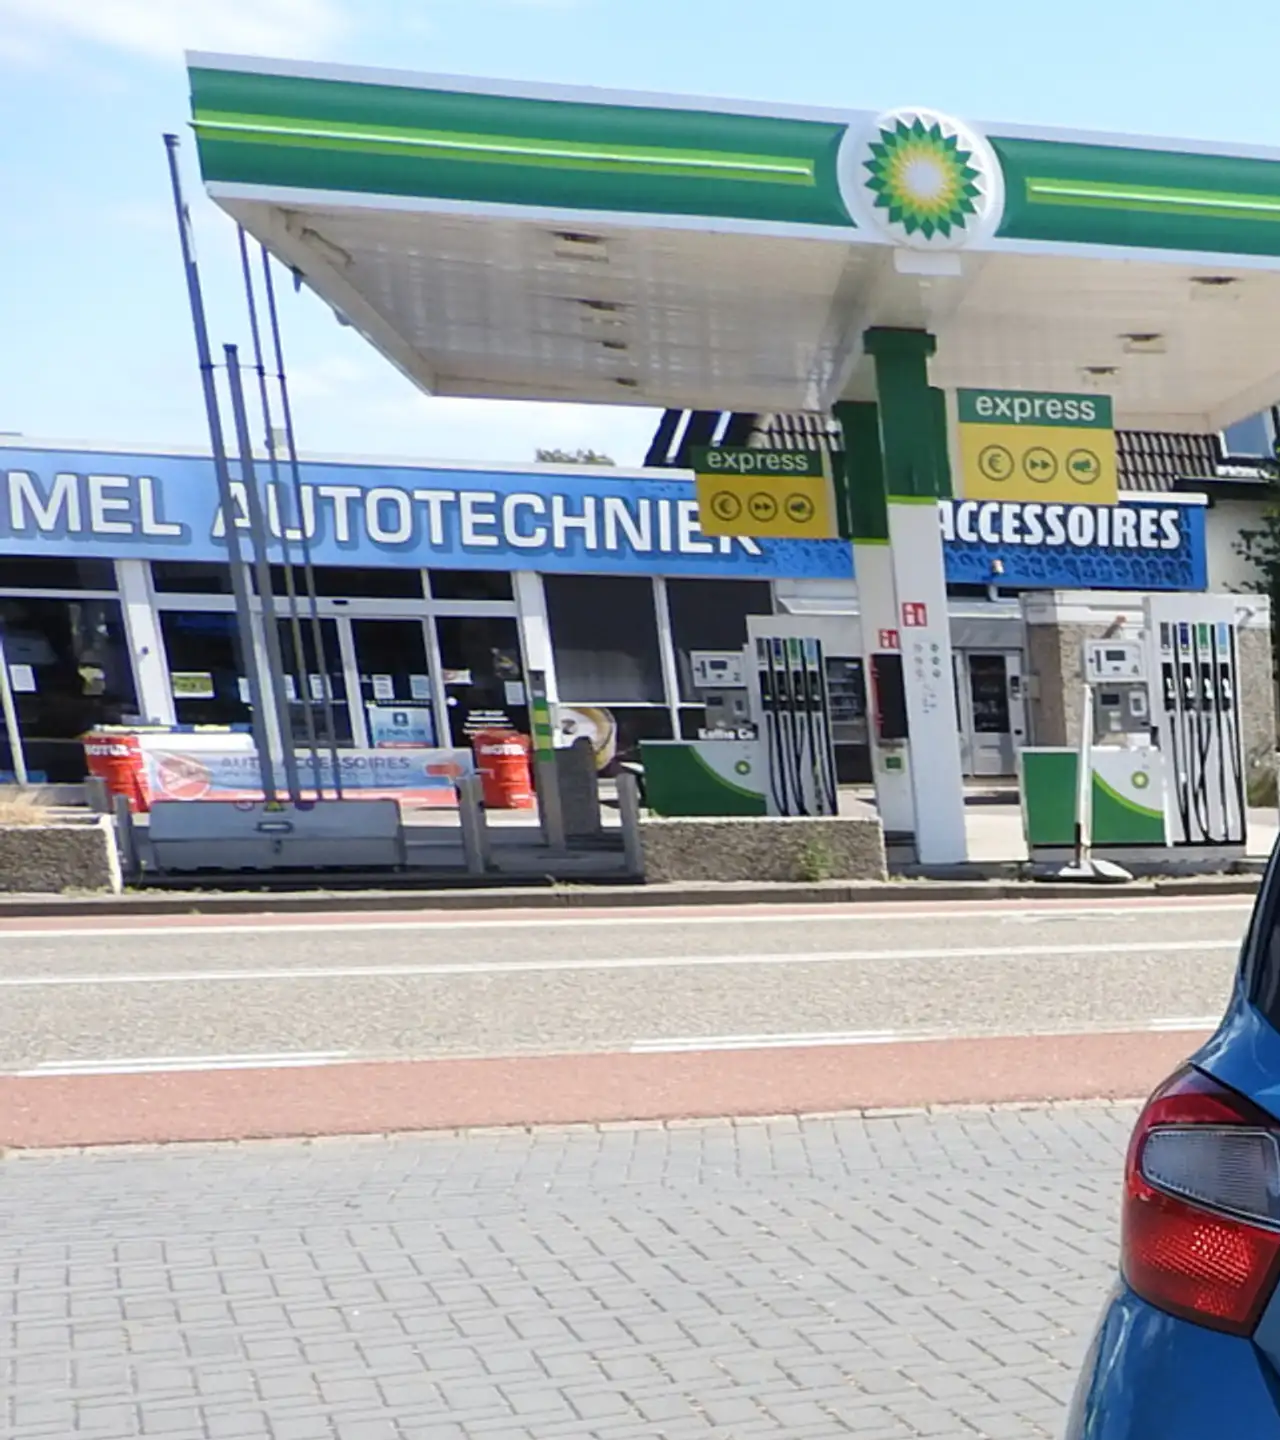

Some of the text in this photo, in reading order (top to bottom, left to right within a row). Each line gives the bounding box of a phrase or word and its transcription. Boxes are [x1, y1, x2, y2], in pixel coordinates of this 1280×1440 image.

[975, 395, 1096, 424] express
[705, 450, 810, 474] express
[937, 500, 1181, 549] ACCESSOIRES
